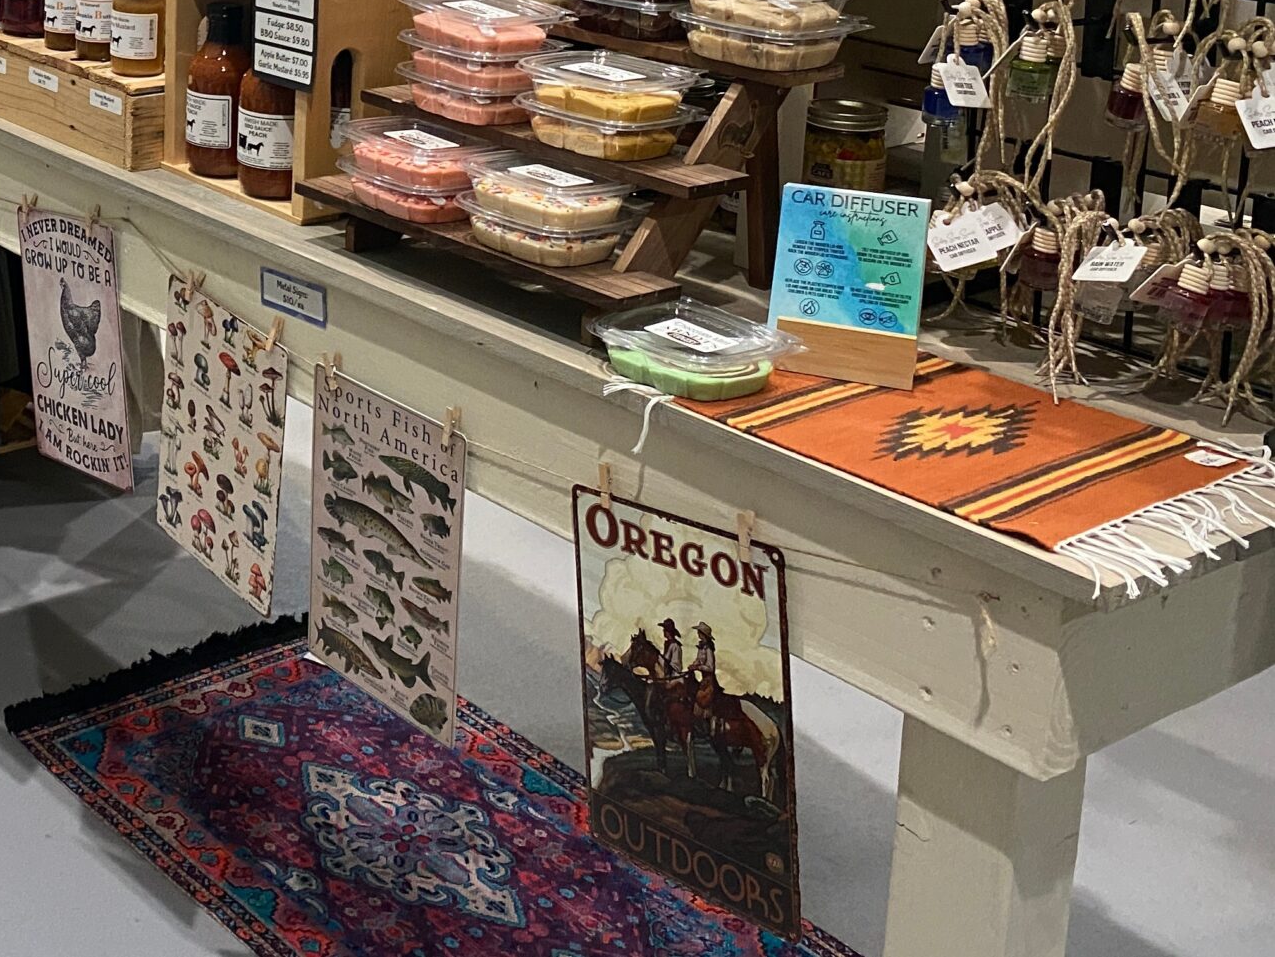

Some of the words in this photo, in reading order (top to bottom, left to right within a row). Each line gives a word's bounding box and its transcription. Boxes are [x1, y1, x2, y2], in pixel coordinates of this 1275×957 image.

[260, 28, 274, 39] BBQ
[292, 36, 311, 47] $9.80
[286, 21, 304, 33] $8.50
[292, 56, 309, 68] $7.00
[294, 68, 310, 80] $5.95
[1250, 119, 1272, 129] PEACH
[791, 190, 825, 208] CAR
[831, 194, 919, 218] DIFFUSER
[819, 209, 837, 219] care
[839, 210, 887, 227] instructions
[21, 229, 27, 243] I
[26, 218, 58, 239] NEVER
[59, 218, 113, 265] DREAMED
[985, 223, 1003, 235] APPLE
[49, 237, 54, 251] I
[55, 238, 82, 259] WOULD
[938, 243, 957, 255] PEACH
[957, 237, 980, 250] NECTAR
[25, 248, 53, 270] GROW
[55, 257, 69, 275] UP
[72, 261, 85, 280] TO
[88, 265, 101, 284] BE
[104, 269, 112, 287] A
[36, 346, 84, 399] Super
[86, 362, 117, 396] cool
[36, 393, 89, 430] CHICKEN
[91, 412, 124, 445] LADY
[323, 375, 382, 419] Sports
[392, 409, 432, 446] Fish
[38, 418, 44, 433] I
[44, 429, 63, 453] AM
[66, 443, 111, 474] ROCKIN'
[317, 393, 371, 436] North
[380, 427, 458, 484] America
[584, 501, 770, 601] OREGON
[599, 802, 784, 925] OUTDOORS
